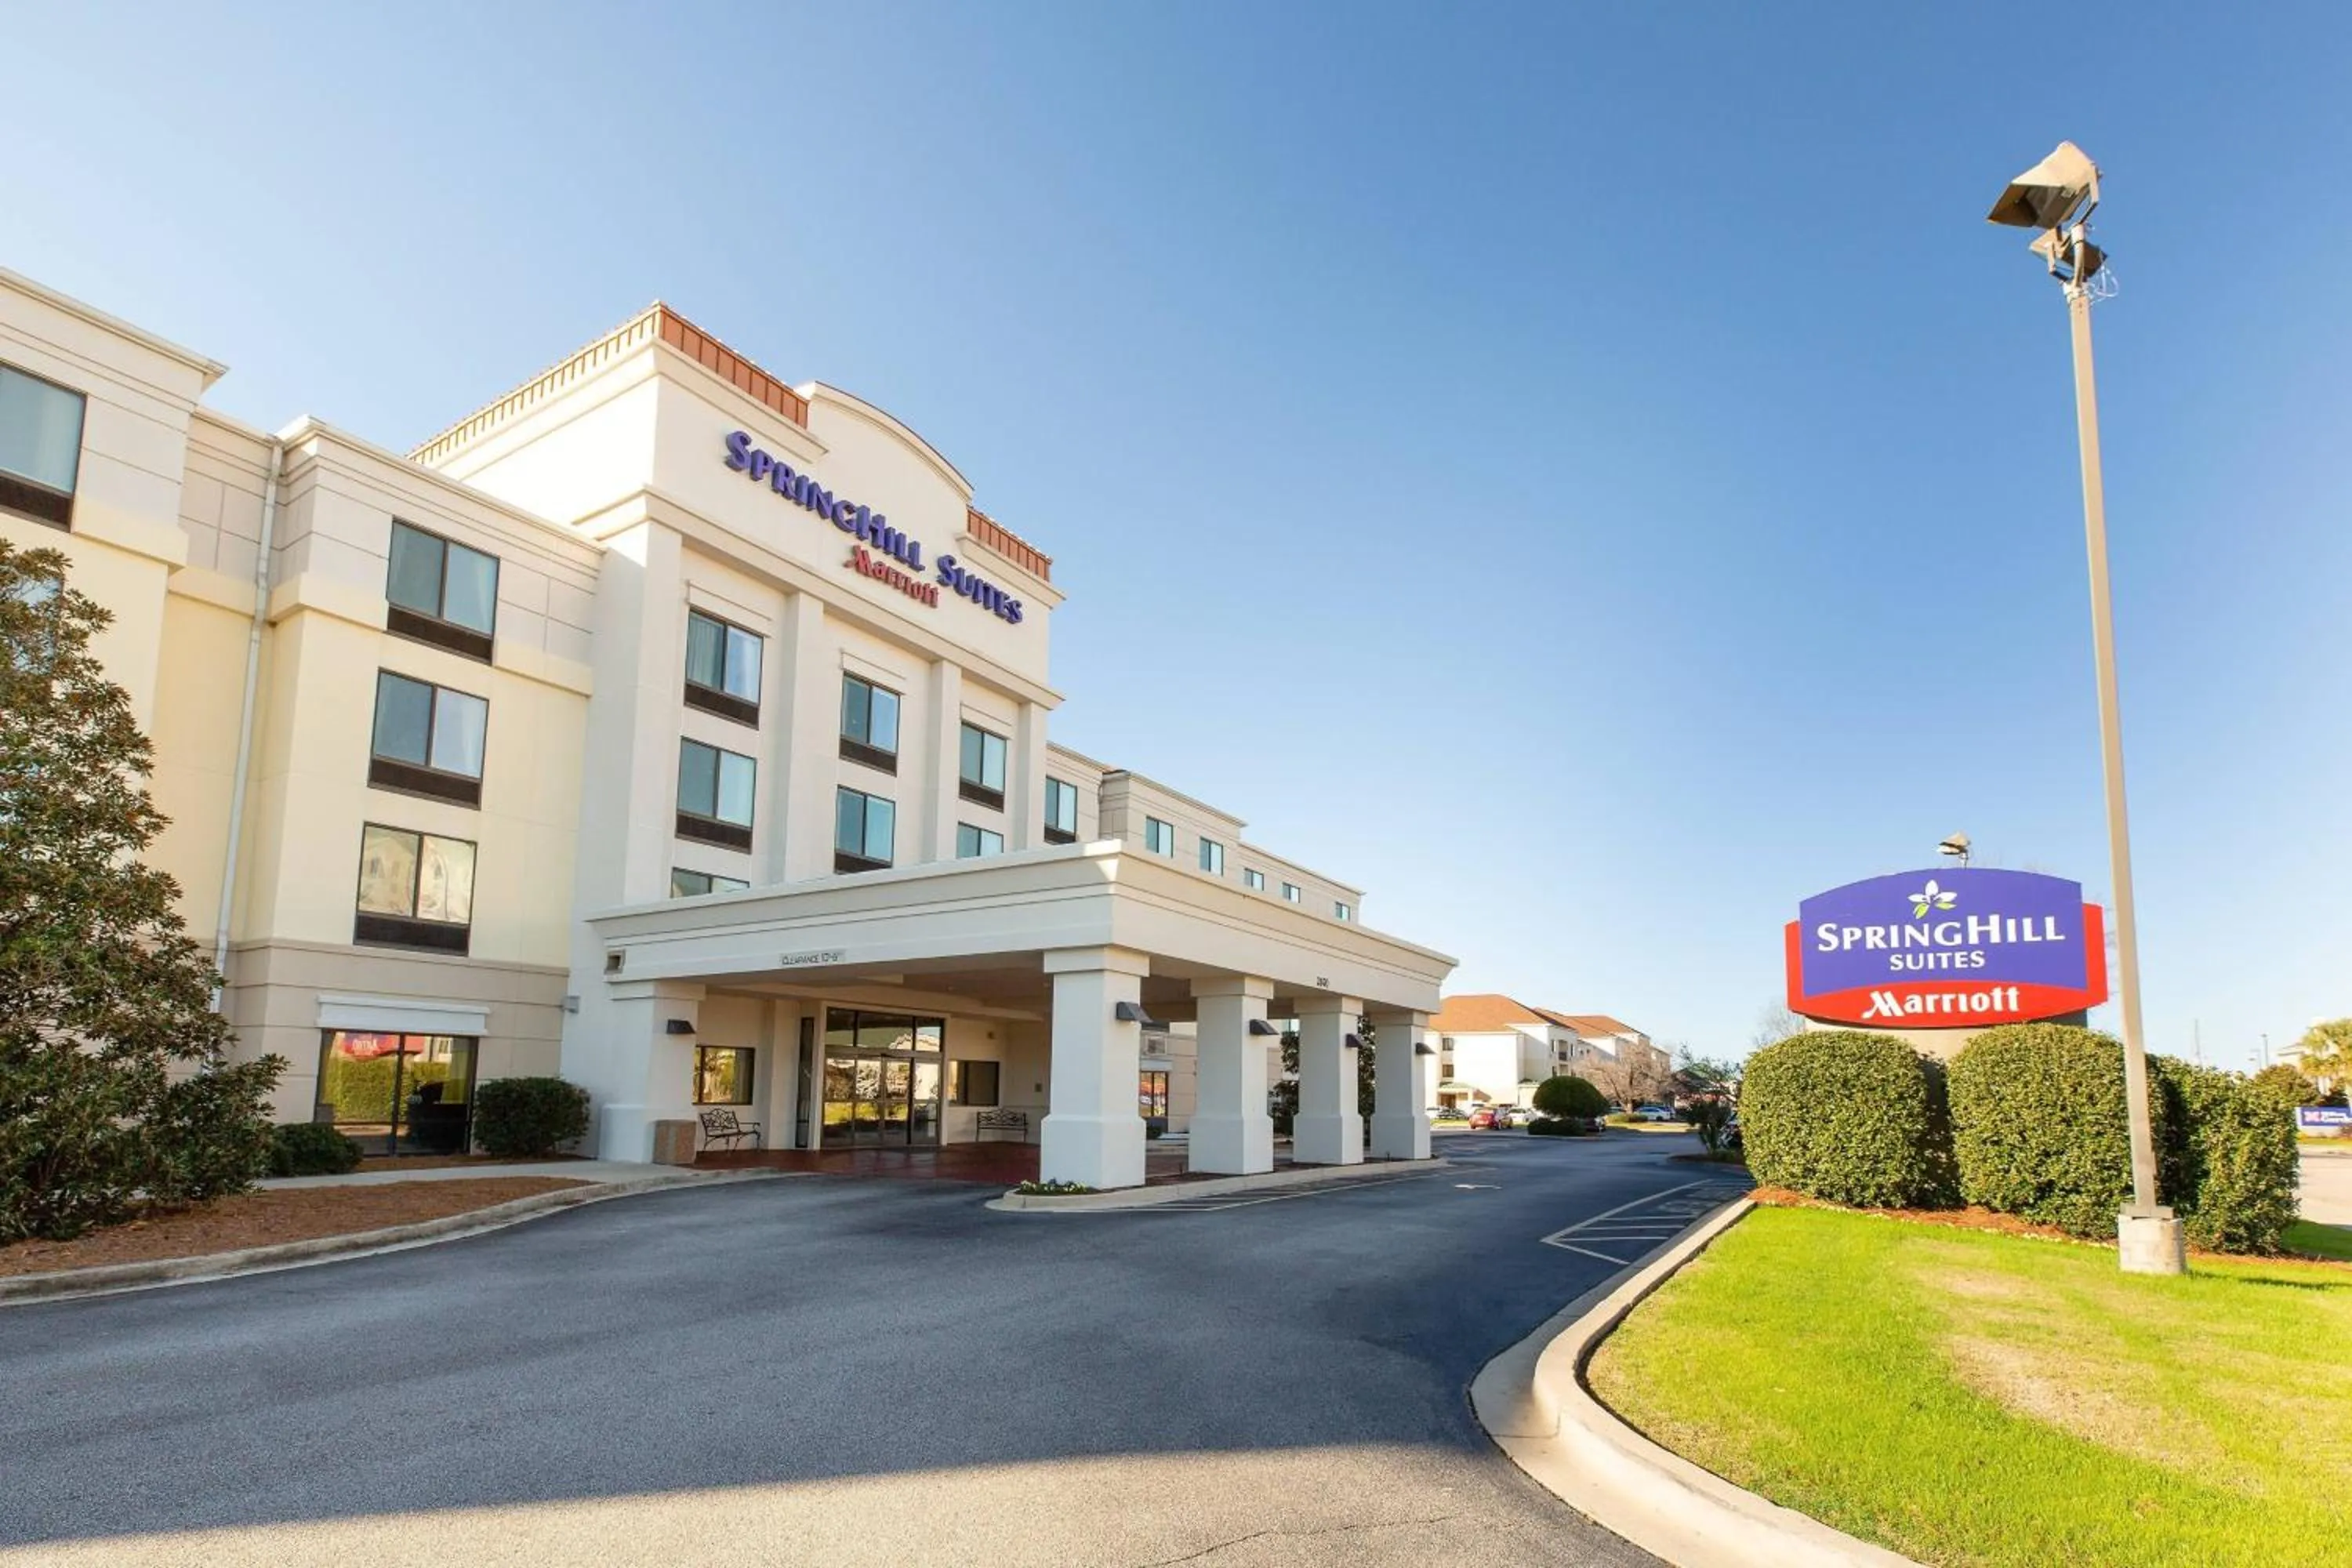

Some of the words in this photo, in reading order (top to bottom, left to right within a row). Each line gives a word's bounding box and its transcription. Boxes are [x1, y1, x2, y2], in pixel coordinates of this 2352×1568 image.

[725, 430, 926, 572] SPRINGHILL
[938, 554, 1022, 625] SUITES
[844, 545, 939, 608] Marriott
[1817, 914, 2066, 952] SPRINGHILL
[1889, 950, 1985, 971] SUITES
[1860, 986, 2020, 1018] Marriott
